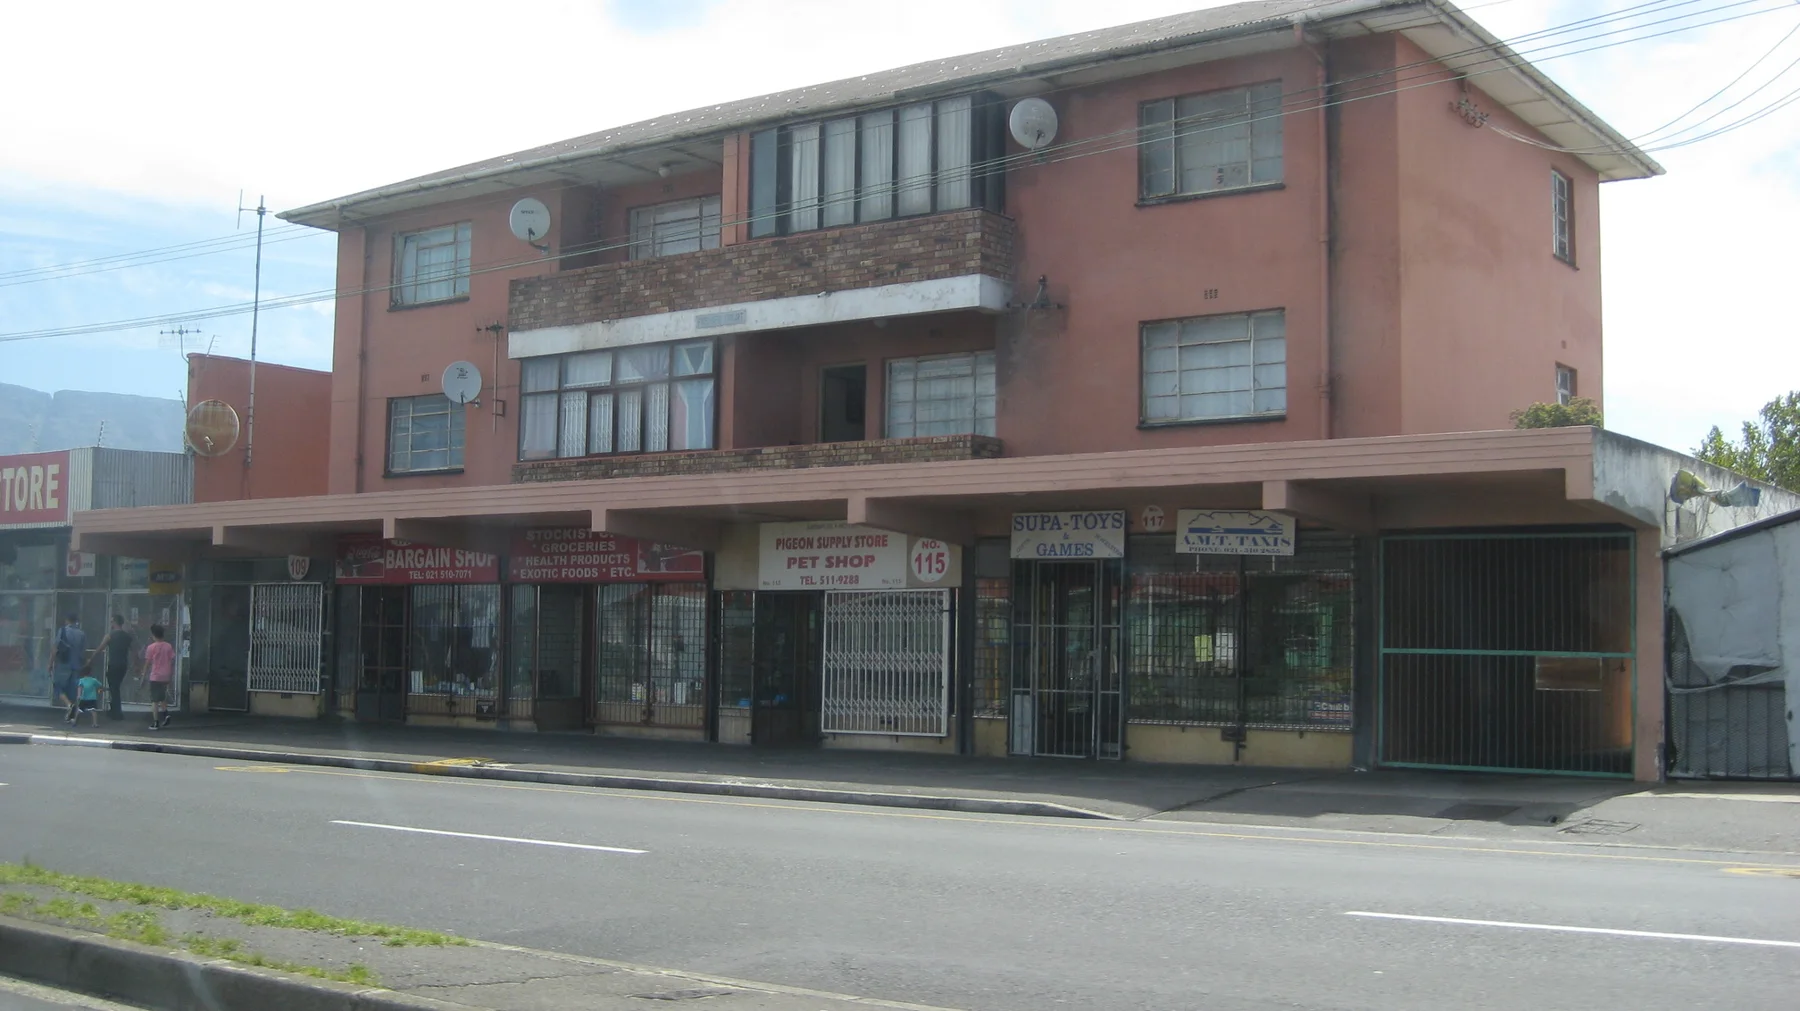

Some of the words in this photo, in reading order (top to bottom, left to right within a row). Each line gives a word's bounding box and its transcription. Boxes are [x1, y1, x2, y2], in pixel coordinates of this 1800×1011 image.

[0, 464, 60, 511] TORE
[1013, 512, 1124, 531] SUPA-TOYS
[1143, 516, 1164, 527] 117
[525, 528, 593, 541] STOCKIST
[1182, 535, 1232, 546] A.M.T.
[1236, 536, 1291, 547] TAXIS
[541, 541, 616, 553] GROCERIES
[776, 537, 814, 550] PIGEON
[817, 536, 852, 549] SUPPLY
[855, 535, 888, 548] STORE
[922, 540, 940, 549] NO.
[1036, 543, 1094, 557] GAMES
[386, 548, 451, 569] BARGAIN
[525, 555, 567, 566] HEALTH
[570, 554, 630, 565] PRODUCTS
[787, 556, 820, 569] PET
[824, 555, 876, 569] SHOP
[915, 552, 945, 574] 115
[291, 559, 306, 575] 109
[520, 568, 558, 579] EXOTIC
[561, 567, 598, 578] FOODS
[610, 567, 636, 578] ETC.
[408, 571, 424, 579] TEL:
[426, 571, 438, 579] 021
[441, 570, 472, 579] 510-7071
[800, 576, 817, 586] TEL.
[820, 575, 860, 585] 511-9288
